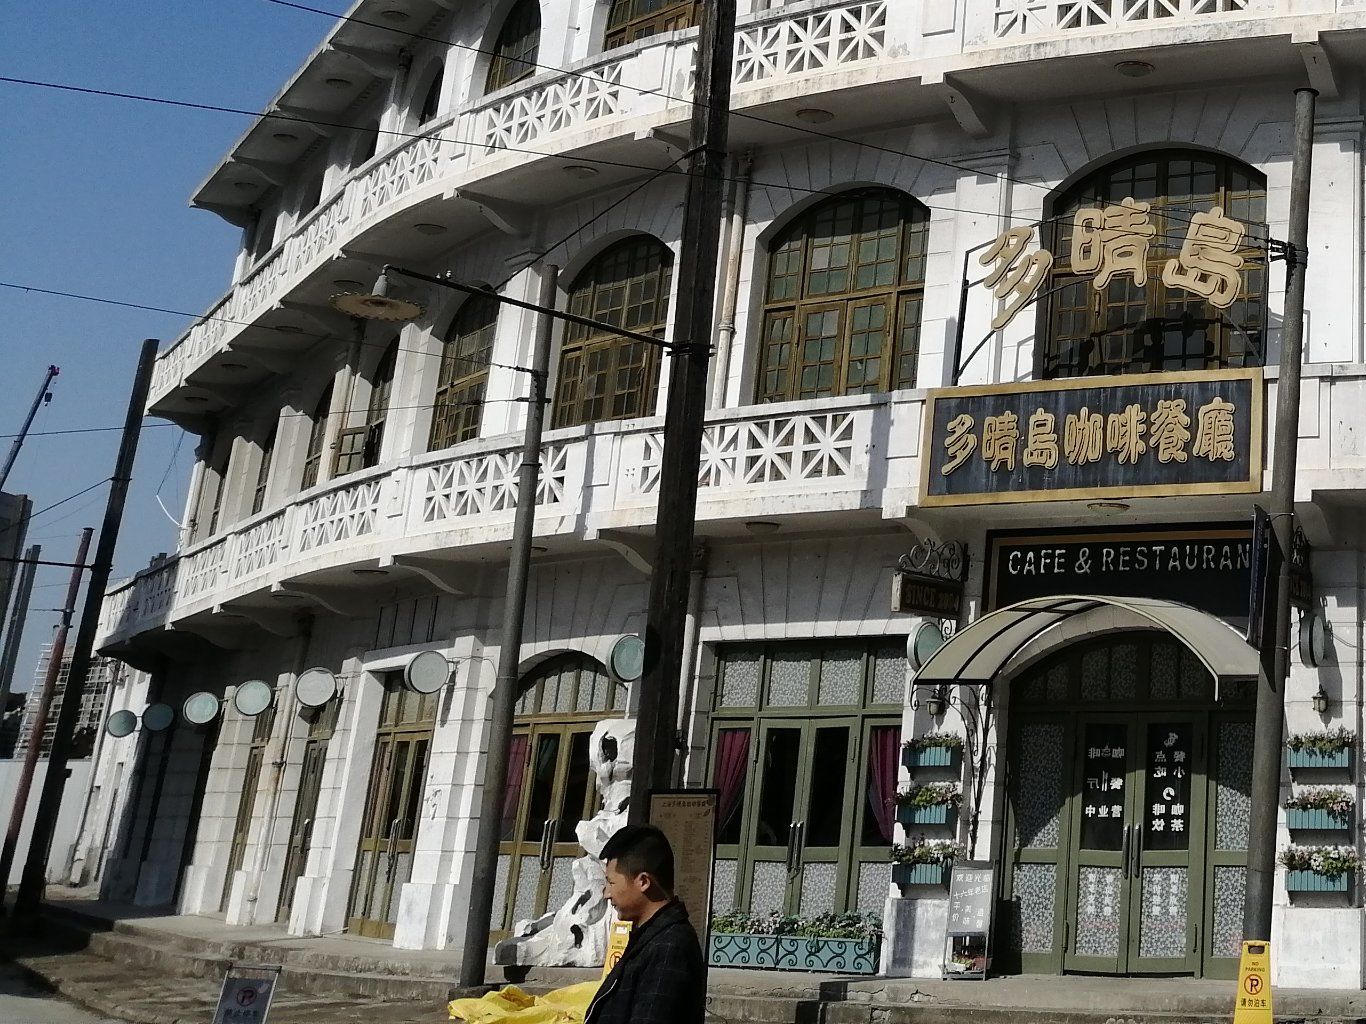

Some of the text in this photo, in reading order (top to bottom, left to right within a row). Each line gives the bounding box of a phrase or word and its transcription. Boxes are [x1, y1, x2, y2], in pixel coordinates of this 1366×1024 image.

[979, 196, 1247, 331] 多晴島
[941, 396, 1236, 476] 多晴島咖啡餐廳
[1008, 543, 1250, 576] CAFE & RESTAURAN
